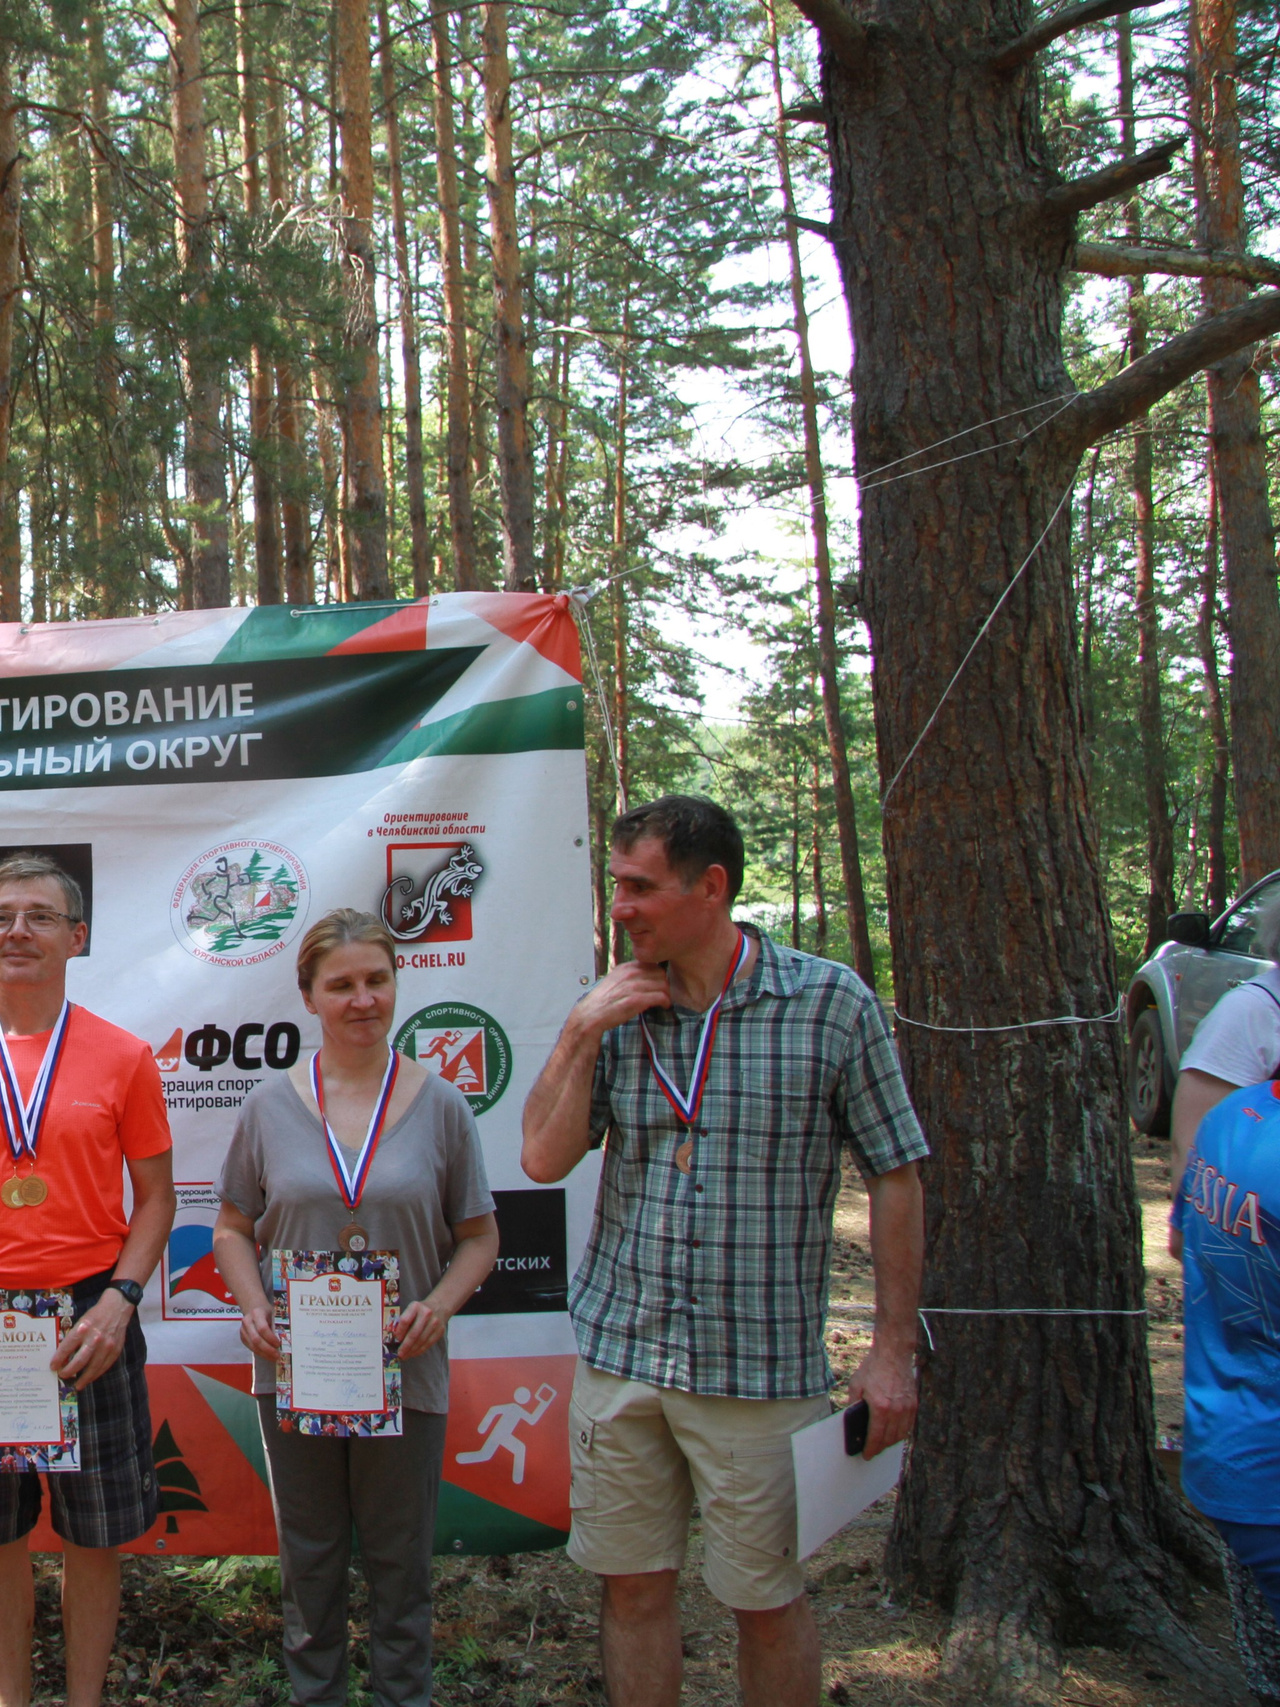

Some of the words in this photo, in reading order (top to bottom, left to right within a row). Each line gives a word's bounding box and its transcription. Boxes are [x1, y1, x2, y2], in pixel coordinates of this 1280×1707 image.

[125, 732, 263, 771] ОКРУГ
[383, 812, 469, 825] Ориентирование
[367, 828, 374, 838] в
[376, 824, 440, 837] Челябинской
[442, 823, 486, 836] области
[172, 863, 200, 909] ФЕДЕРАЦИЯ
[200, 840, 258, 865] СПОРТИВНОГО
[258, 841, 307, 891] ОРИЕНТИРОВАНИЯ
[192, 947, 243, 967] КУРГАНСКОЙ
[245, 941, 286, 964] ОБЛАСТИ
[184, 1021, 301, 1072] ФСО
[397, 1019, 422, 1054] ДЕРАЦИЯ
[425, 1007, 486, 1025] СПОРТИВНОГО
[485, 1027, 506, 1101] ОРИЕНТИРОВАНИЯ
[161, 1080, 213, 1095] ерация
[490, 1256, 551, 1271] ТСКИХ
[299, 1293, 372, 1307] ГРАМОТА
